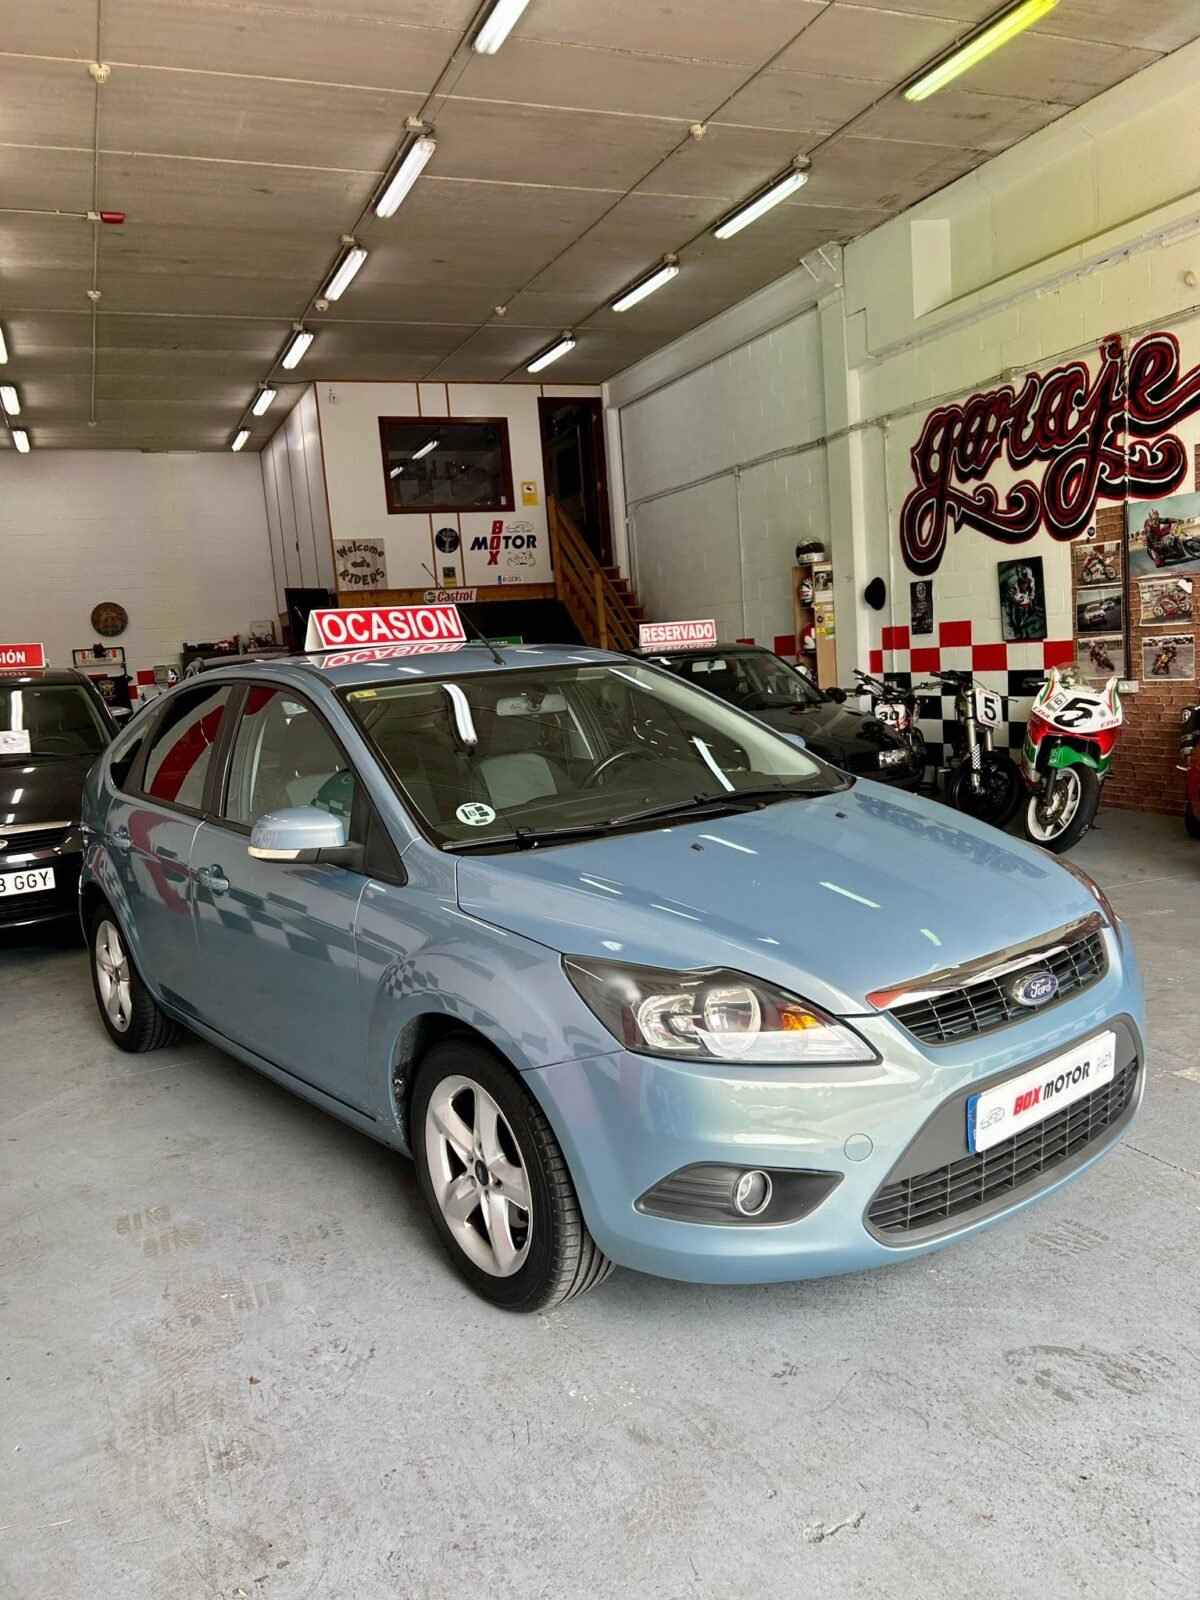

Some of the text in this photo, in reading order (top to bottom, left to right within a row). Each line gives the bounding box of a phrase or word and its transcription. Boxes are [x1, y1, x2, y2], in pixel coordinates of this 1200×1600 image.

[900, 332, 1200, 576] garaje
[336, 540, 384, 558] Welcome
[470, 535, 537, 550] MOTOR
[487, 520, 503, 565] BOX
[339, 568, 385, 586] RIDERS
[437, 590, 474, 603] Castrol
[321, 609, 461, 643] OCASION
[642, 623, 713, 642] RESERVADO
[879, 711, 900, 721] 30
[984, 697, 997, 721] 5
[1053, 697, 1102, 728] 5
[14, 871, 49, 890] GGY
[1030, 977, 1054, 998] Ford
[1013, 1060, 1091, 1117] BOX MOTOR
